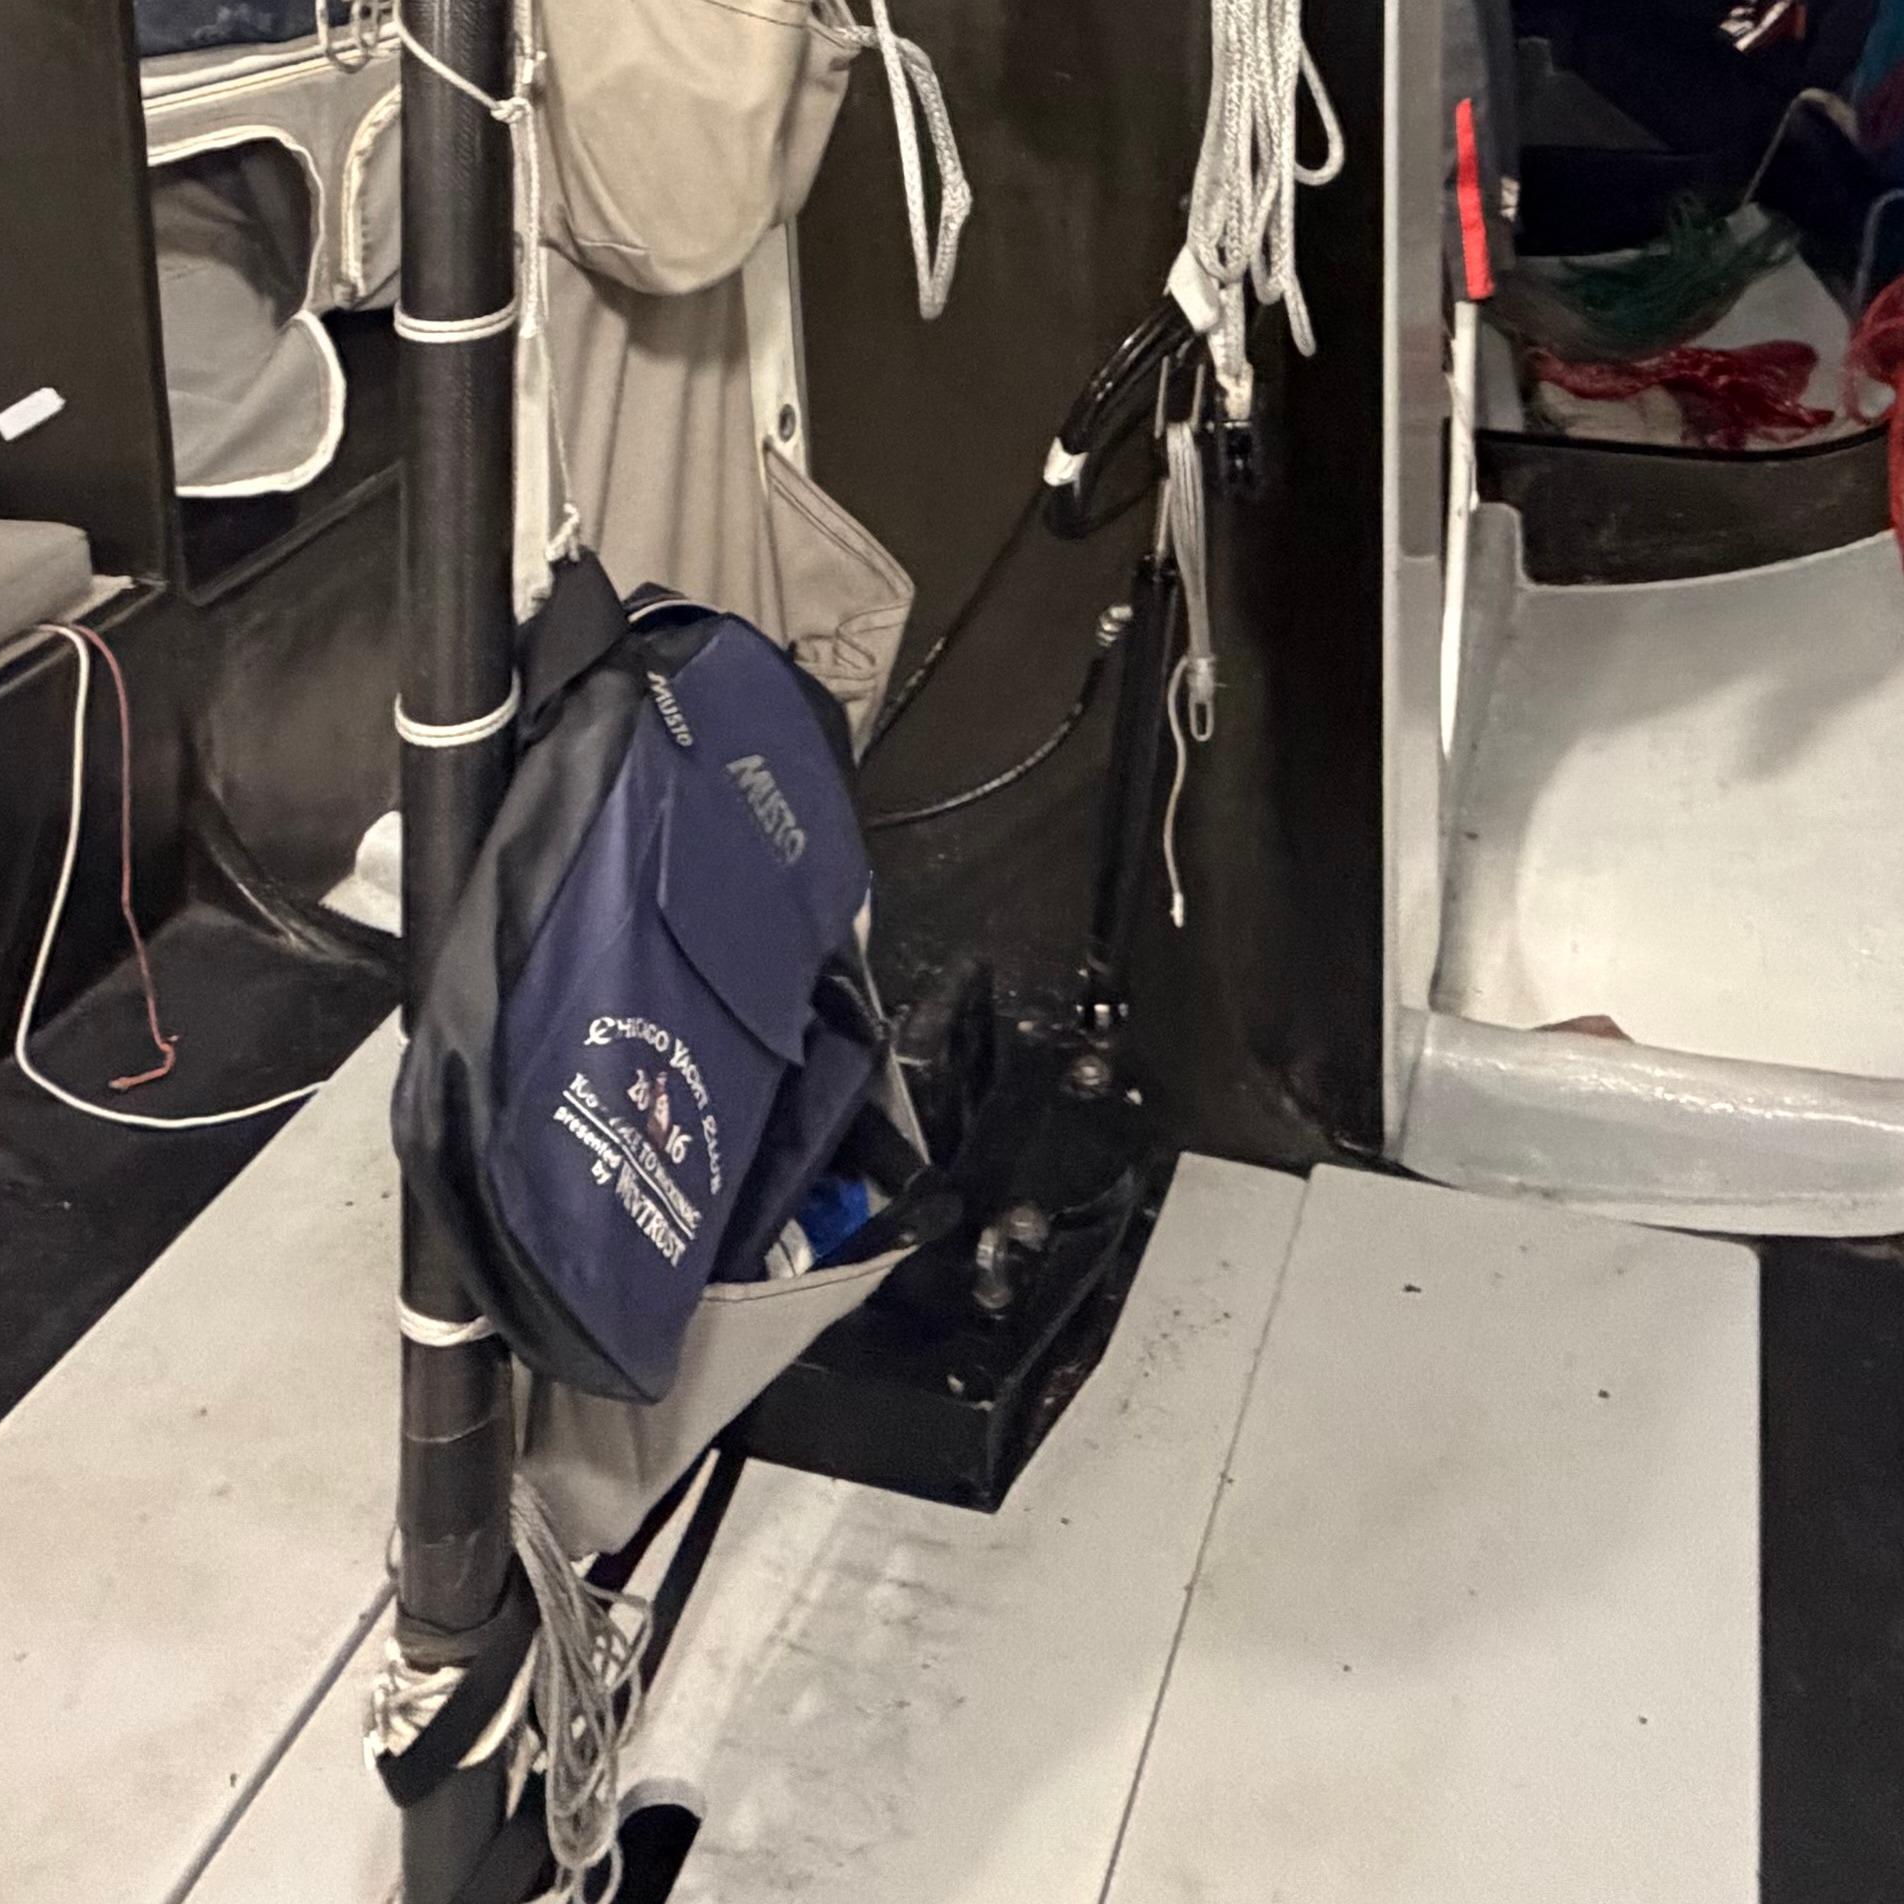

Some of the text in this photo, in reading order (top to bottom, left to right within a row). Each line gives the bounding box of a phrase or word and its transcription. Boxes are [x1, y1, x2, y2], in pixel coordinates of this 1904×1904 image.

[647, 671, 693, 746] MUSTO
[725, 754, 807, 866] MUSTO
[553, 1106, 622, 1169] presented
[639, 1141, 658, 1172] TO
[591, 1159, 612, 1185] by
